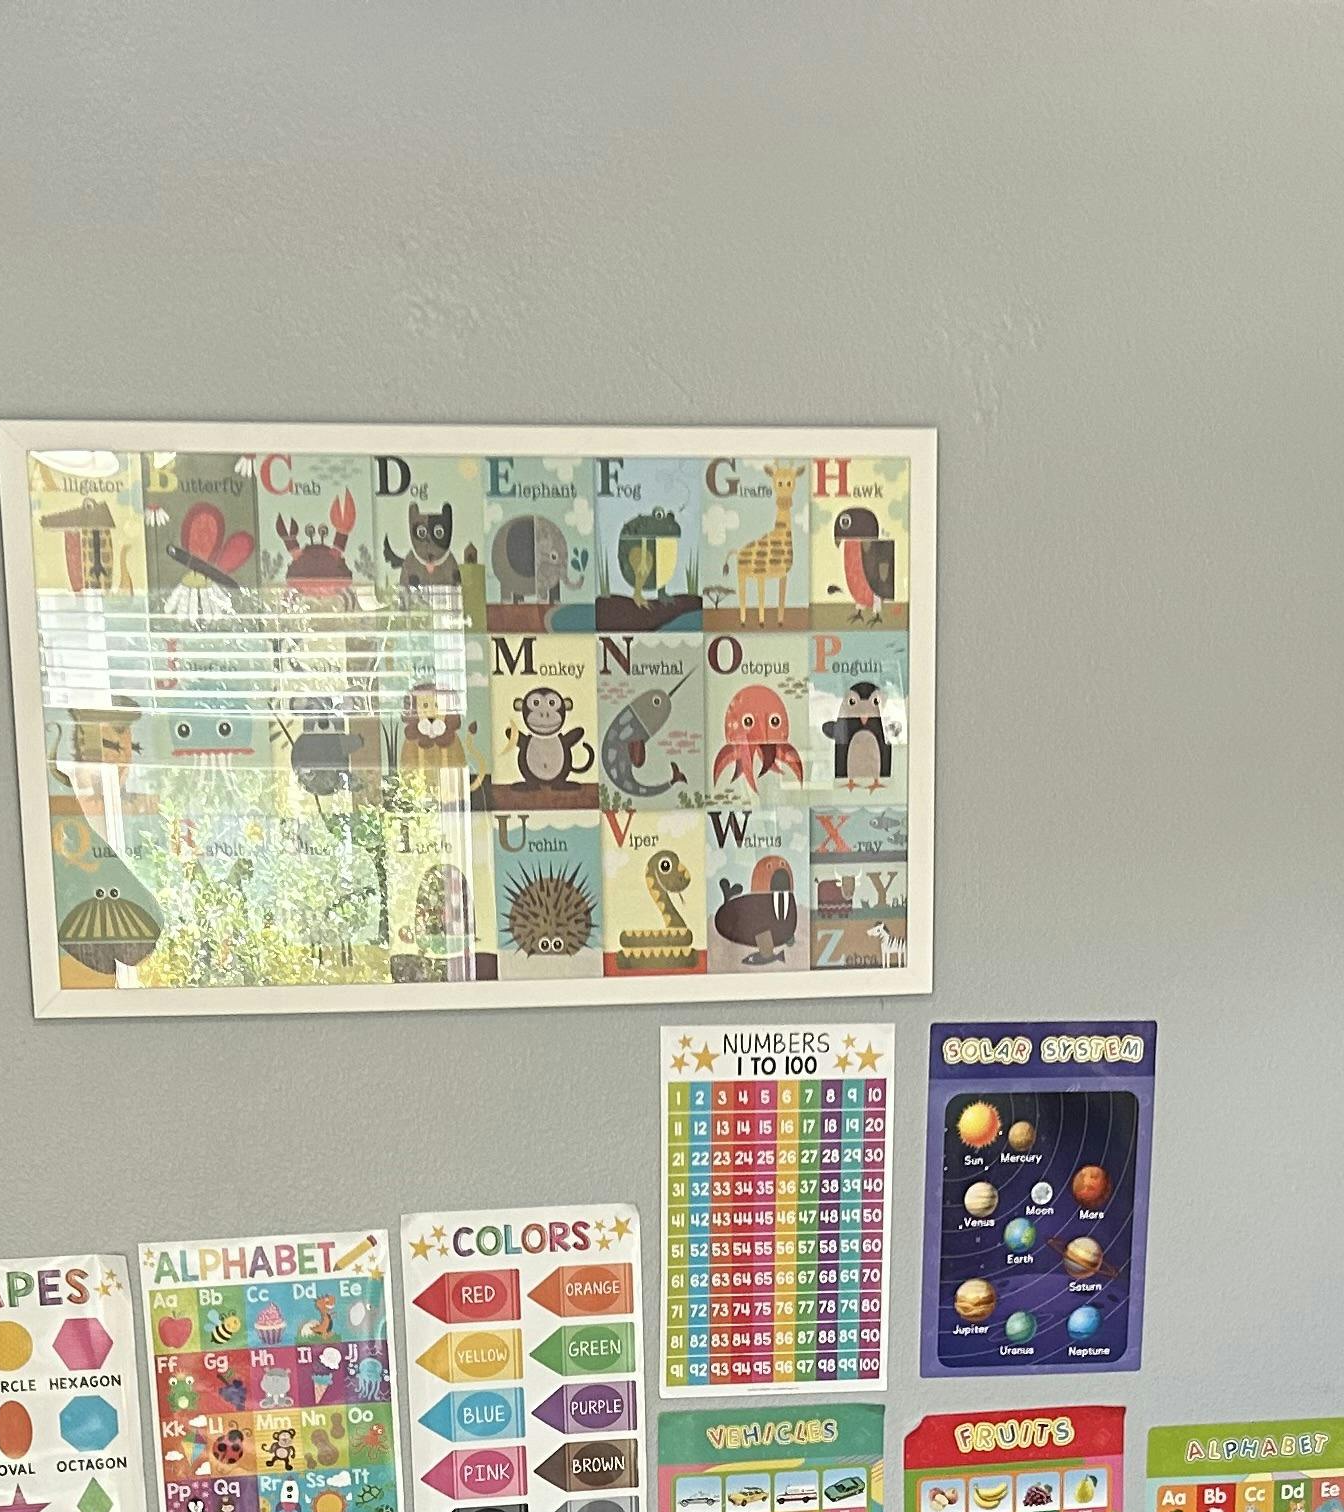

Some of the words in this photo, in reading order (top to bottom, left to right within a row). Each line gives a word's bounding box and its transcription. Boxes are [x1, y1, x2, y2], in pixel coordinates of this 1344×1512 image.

[260, 454, 321, 496] Crab
[375, 455, 429, 500] Dog
[486, 458, 576, 499] Elephant
[597, 458, 641, 500] Frog
[706, 458, 773, 498] Giraffe
[813, 458, 884, 498] Hawk
[492, 637, 585, 678] Monkey
[599, 636, 684, 676] Narwhal
[708, 635, 789, 676] Octopus
[812, 634, 883, 676] Penguin
[495, 814, 568, 853] Urchin
[602, 809, 659, 849] Viper
[708, 810, 782, 849] Walrus
[815, 815, 882, 853] X-ray
[723, 1033, 830, 1055] NUMBERS
[944, 1037, 1030, 1063] SOLAR
[1042, 1036, 1143, 1064] SYSTEM
[750, 1058, 775, 1074] TO
[785, 1056, 817, 1074] 100
[676, 1090, 681, 1105] 1
[695, 1090, 705, 1106] 2
[718, 1090, 727, 1104] 3
[738, 1090, 748, 1105] 4
[760, 1090, 769, 1103] 5
[782, 1089, 791, 1103] 6
[804, 1089, 813, 1103] 7
[826, 1088, 835, 1103] 8
[847, 1087, 856, 1102] 9
[868, 1087, 882, 1103] 10
[964, 1155, 984, 1166] Sun
[1000, 1152, 1042, 1164] Mercury
[1026, 1205, 1053, 1216] Moon
[1079, 1209, 1104, 1220] Mars
[964, 1217, 994, 1228] Venus
[453, 1221, 592, 1257] COLORS
[154, 1241, 336, 1284] ALPHABET
[1007, 1253, 1033, 1265] Earth
[153, 1292, 178, 1308] Aa
[199, 1289, 223, 1305] Bb
[247, 1287, 269, 1303] Cc
[293, 1284, 317, 1299] Dd
[340, 1281, 362, 1297] Ee
[461, 1285, 496, 1304] RED
[566, 1280, 621, 1296] ORANGE
[1069, 1281, 1102, 1292] Saturn
[952, 1323, 990, 1337] Jupiter
[457, 1348, 507, 1365] YELLOW
[568, 1341, 621, 1358] GREEN
[999, 1345, 1034, 1355] Uranus
[1068, 1345, 1110, 1358] Neptune
[49, 1374, 122, 1389] HEXAGON
[464, 1406, 505, 1424] BLUE
[571, 1398, 622, 1415] PURPLE
[706, 1419, 838, 1450] VEHICLES
[955, 1417, 1075, 1452] FRUITS
[1187, 1433, 1328, 1462] ALPHABET
[57, 1457, 127, 1471] OCTAGON
[464, 1465, 510, 1482] PINK
[572, 1456, 625, 1473] BROWN
[1162, 1490, 1186, 1505] Aa
[1204, 1489, 1226, 1504] Bb
[1244, 1487, 1265, 1502] Cc
[1281, 1484, 1304, 1499] Dd
[1321, 1482, 1340, 1497] Ee
